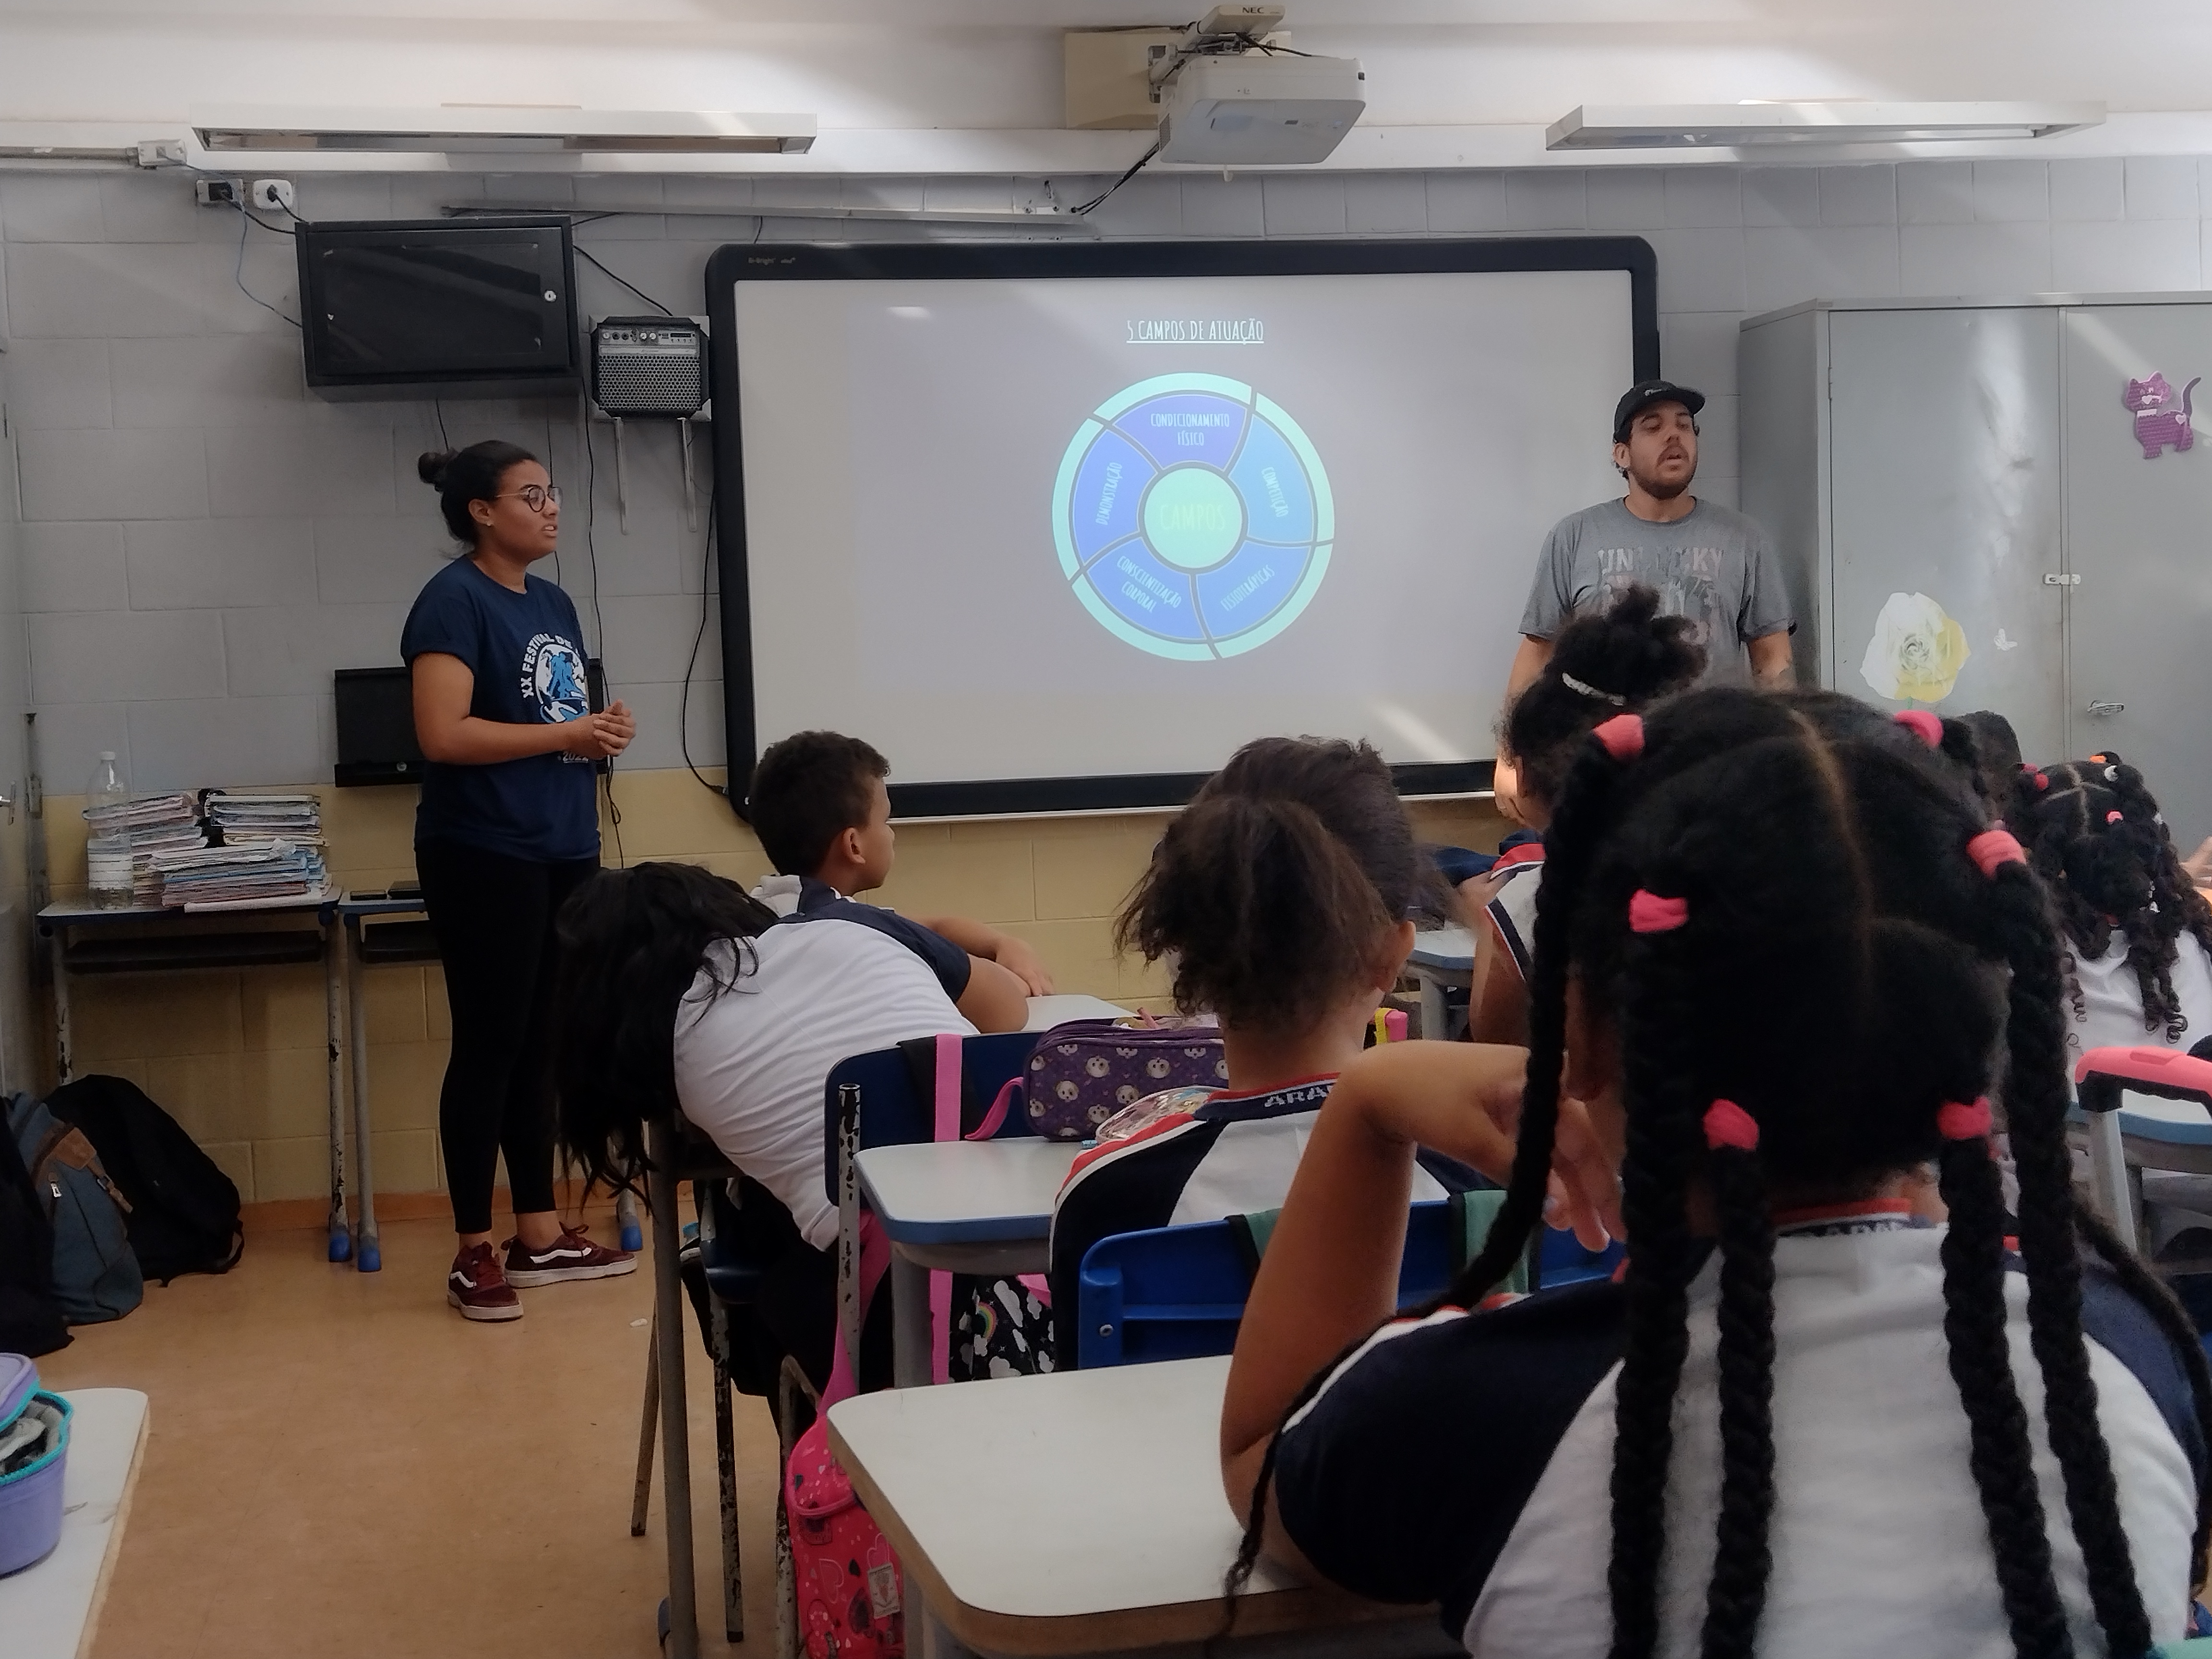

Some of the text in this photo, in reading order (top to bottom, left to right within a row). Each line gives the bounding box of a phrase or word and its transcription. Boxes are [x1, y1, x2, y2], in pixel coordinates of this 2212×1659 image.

[1127, 318, 1264, 345] 5 CAMPOS DE ATUAÇÃO
[1151, 413, 1230, 427] CONDICIONAMENTO
[1177, 430, 1204, 446] FÍSICO
[1095, 461, 1123, 526] DEMONSTRAÇÃO
[1261, 467, 1289, 518] COMPETIÇÃO
[1160, 504, 1226, 530] CAMPOS
[1116, 555, 1182, 609] CONSCIENTIZAÇÃO
[1121, 581, 1157, 613] CORPORAL
[522, 633, 555, 673] FESTIVAL
[521, 676, 534, 698] XX
